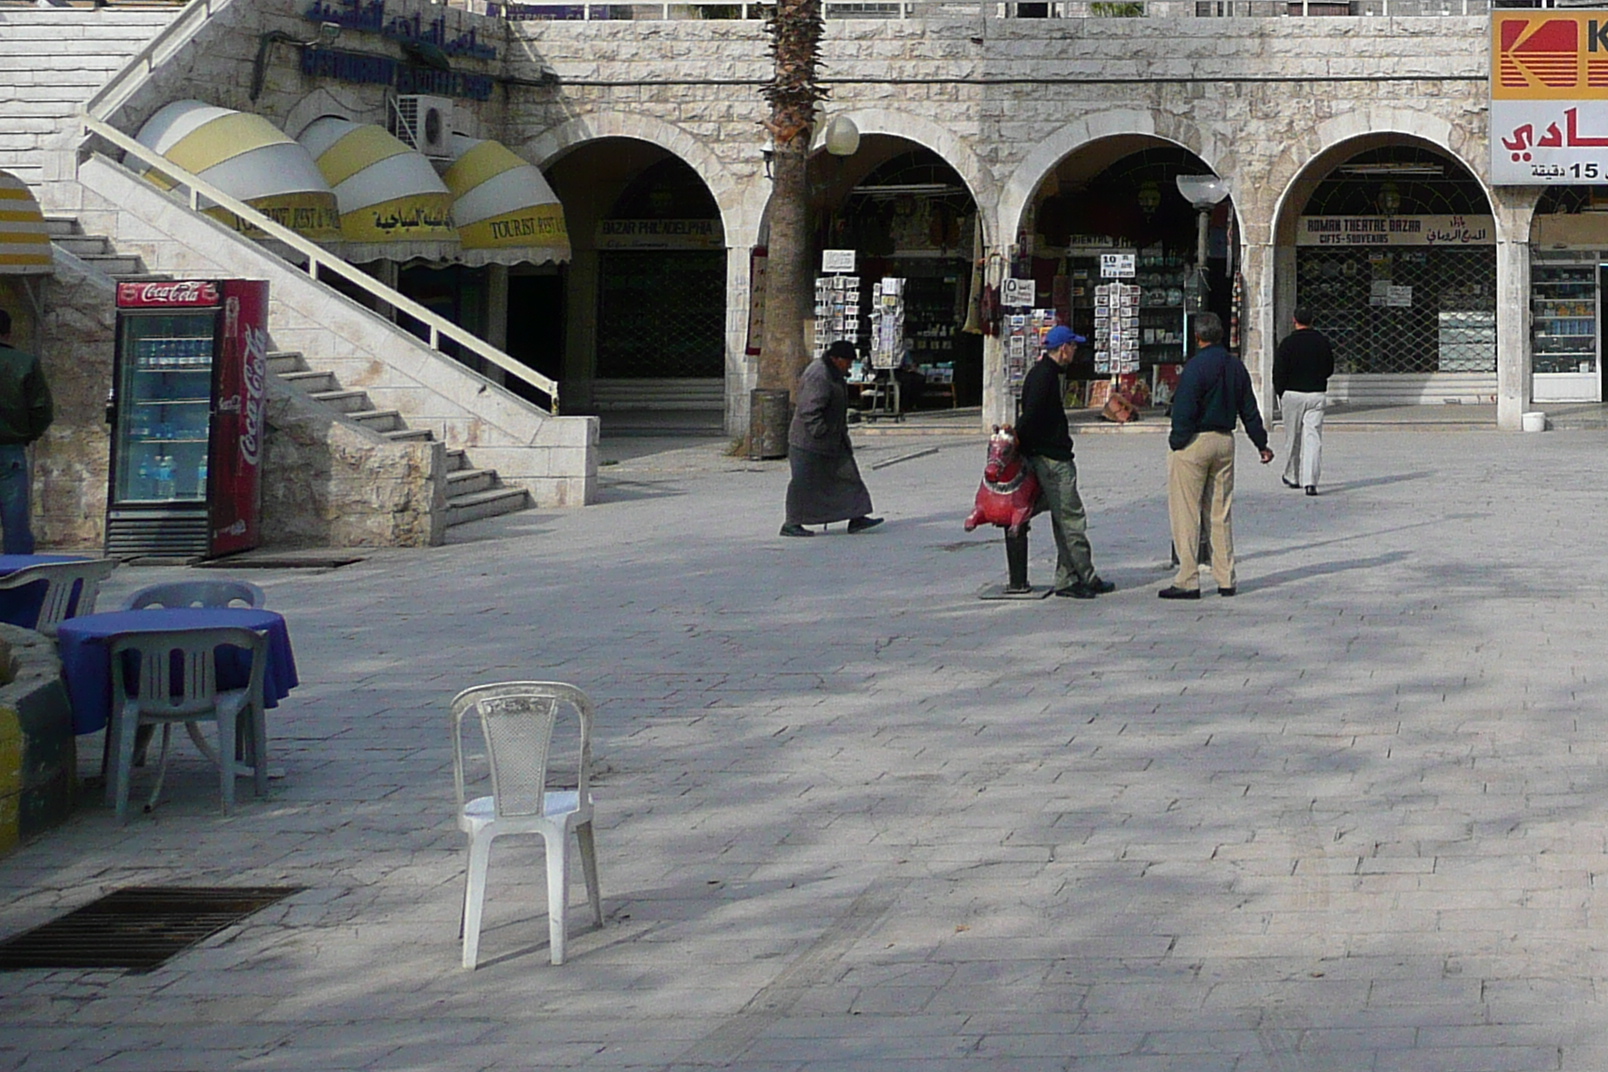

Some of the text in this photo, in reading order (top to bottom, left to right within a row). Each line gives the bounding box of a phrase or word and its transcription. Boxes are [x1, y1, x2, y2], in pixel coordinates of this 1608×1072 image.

[1531, 164, 1566, 179] دقيقة
[1569, 163, 1599, 178] 15
[490, 217, 535, 239] TOURIST
[1307, 219, 1421, 233] ROMAN THEATRE BAZAR
[1103, 255, 1117, 263] 10
[141, 281, 199, 303] Coca-Cola
[1003, 279, 1017, 295] 10
[239, 323, 269, 466] Coca-Cola
